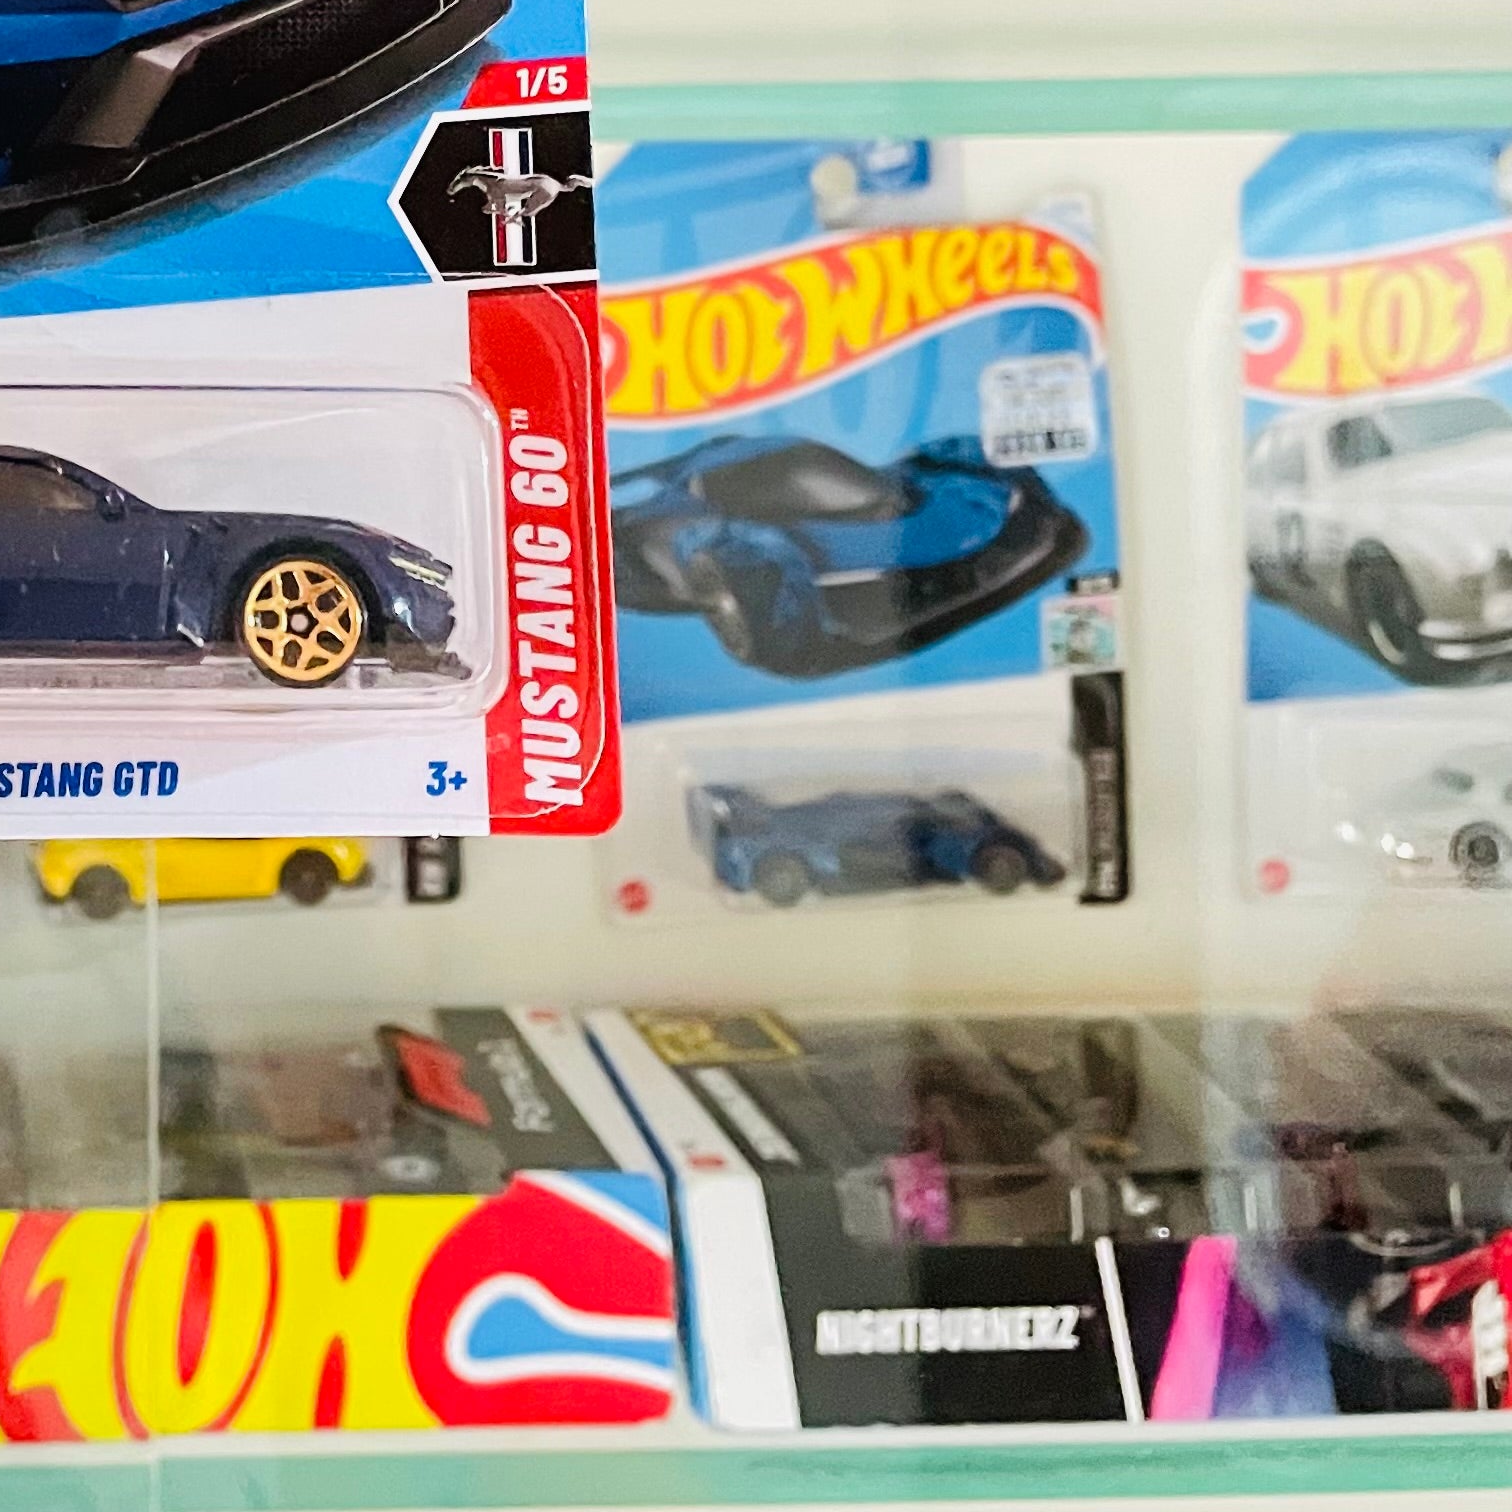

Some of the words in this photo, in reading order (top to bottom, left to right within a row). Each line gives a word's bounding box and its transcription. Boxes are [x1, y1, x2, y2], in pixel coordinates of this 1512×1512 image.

[516, 65, 568, 98] 1/5
[602, 281, 792, 414] HOT
[1264, 256, 1472, 391] HOT
[511, 523, 584, 806] MUSTANG
[113, 760, 179, 797] GTD
[425, 760, 469, 796] 3+
